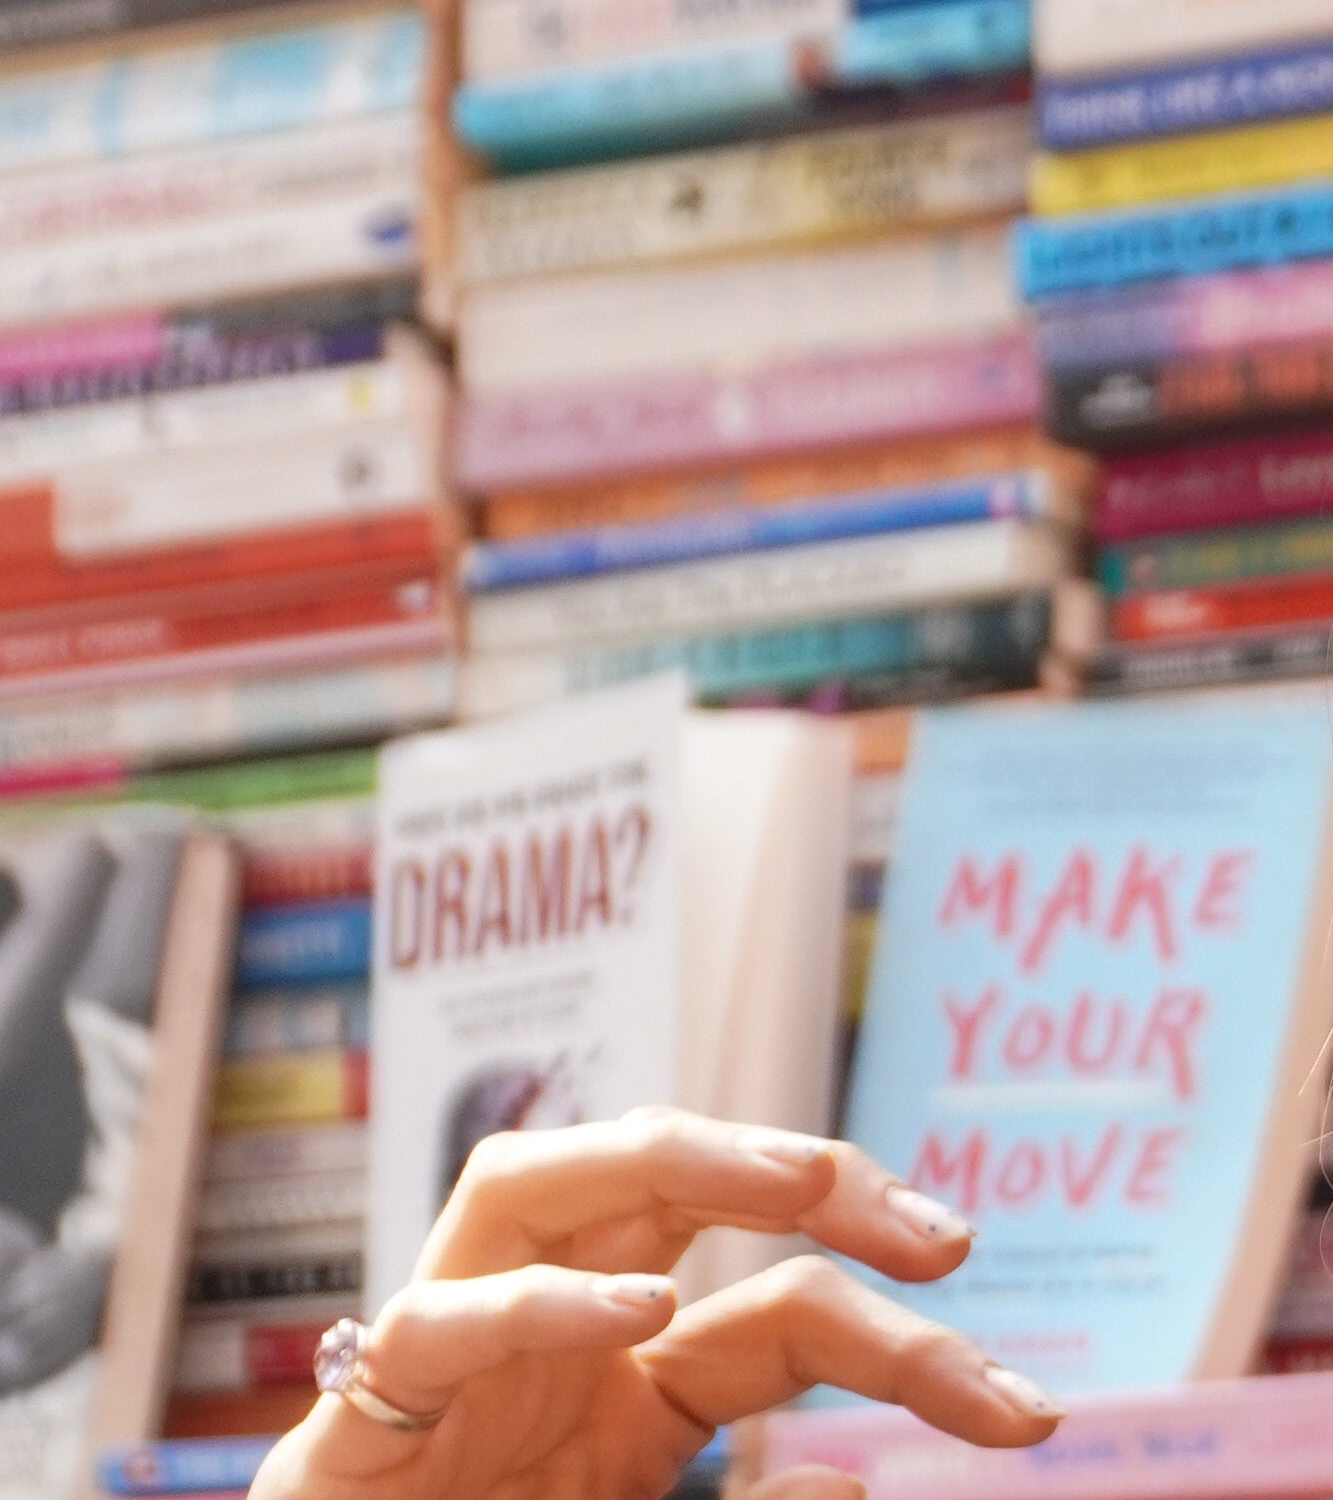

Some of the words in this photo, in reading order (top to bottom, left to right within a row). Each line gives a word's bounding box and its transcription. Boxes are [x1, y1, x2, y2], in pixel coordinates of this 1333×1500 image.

[391, 803, 655, 972] DRAMA?
[934, 843, 1256, 977] MAKE
[940, 982, 1208, 1103] YOUR
[905, 1121, 1190, 1214] MOVE
